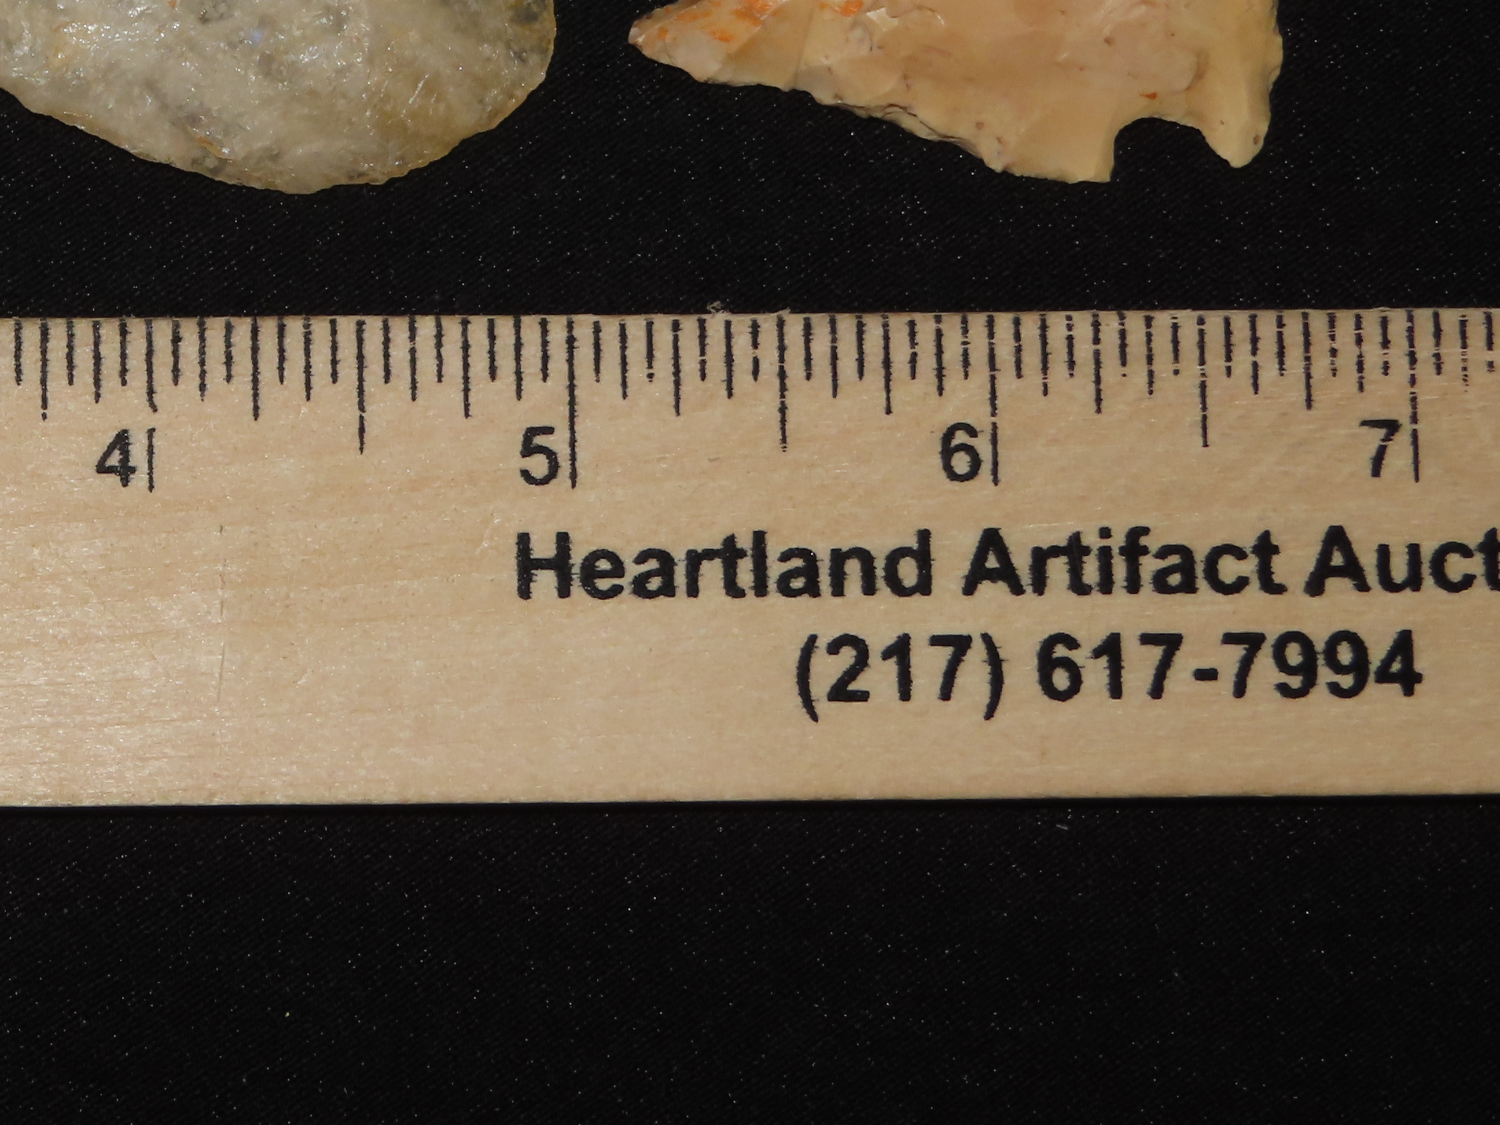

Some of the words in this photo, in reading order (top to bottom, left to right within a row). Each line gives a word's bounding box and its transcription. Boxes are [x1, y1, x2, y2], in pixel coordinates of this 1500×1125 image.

[95, 428, 137, 488] 4
[519, 425, 562, 487] 5
[938, 421, 984, 483] 6
[1358, 418, 1403, 479] 7
[516, 527, 936, 601] Heartland
[961, 525, 1289, 598] Artifact
[1302, 524, 1500, 599] Auct
[795, 631, 1007, 724] (217)
[1035, 628, 1424, 704] 617-7994
